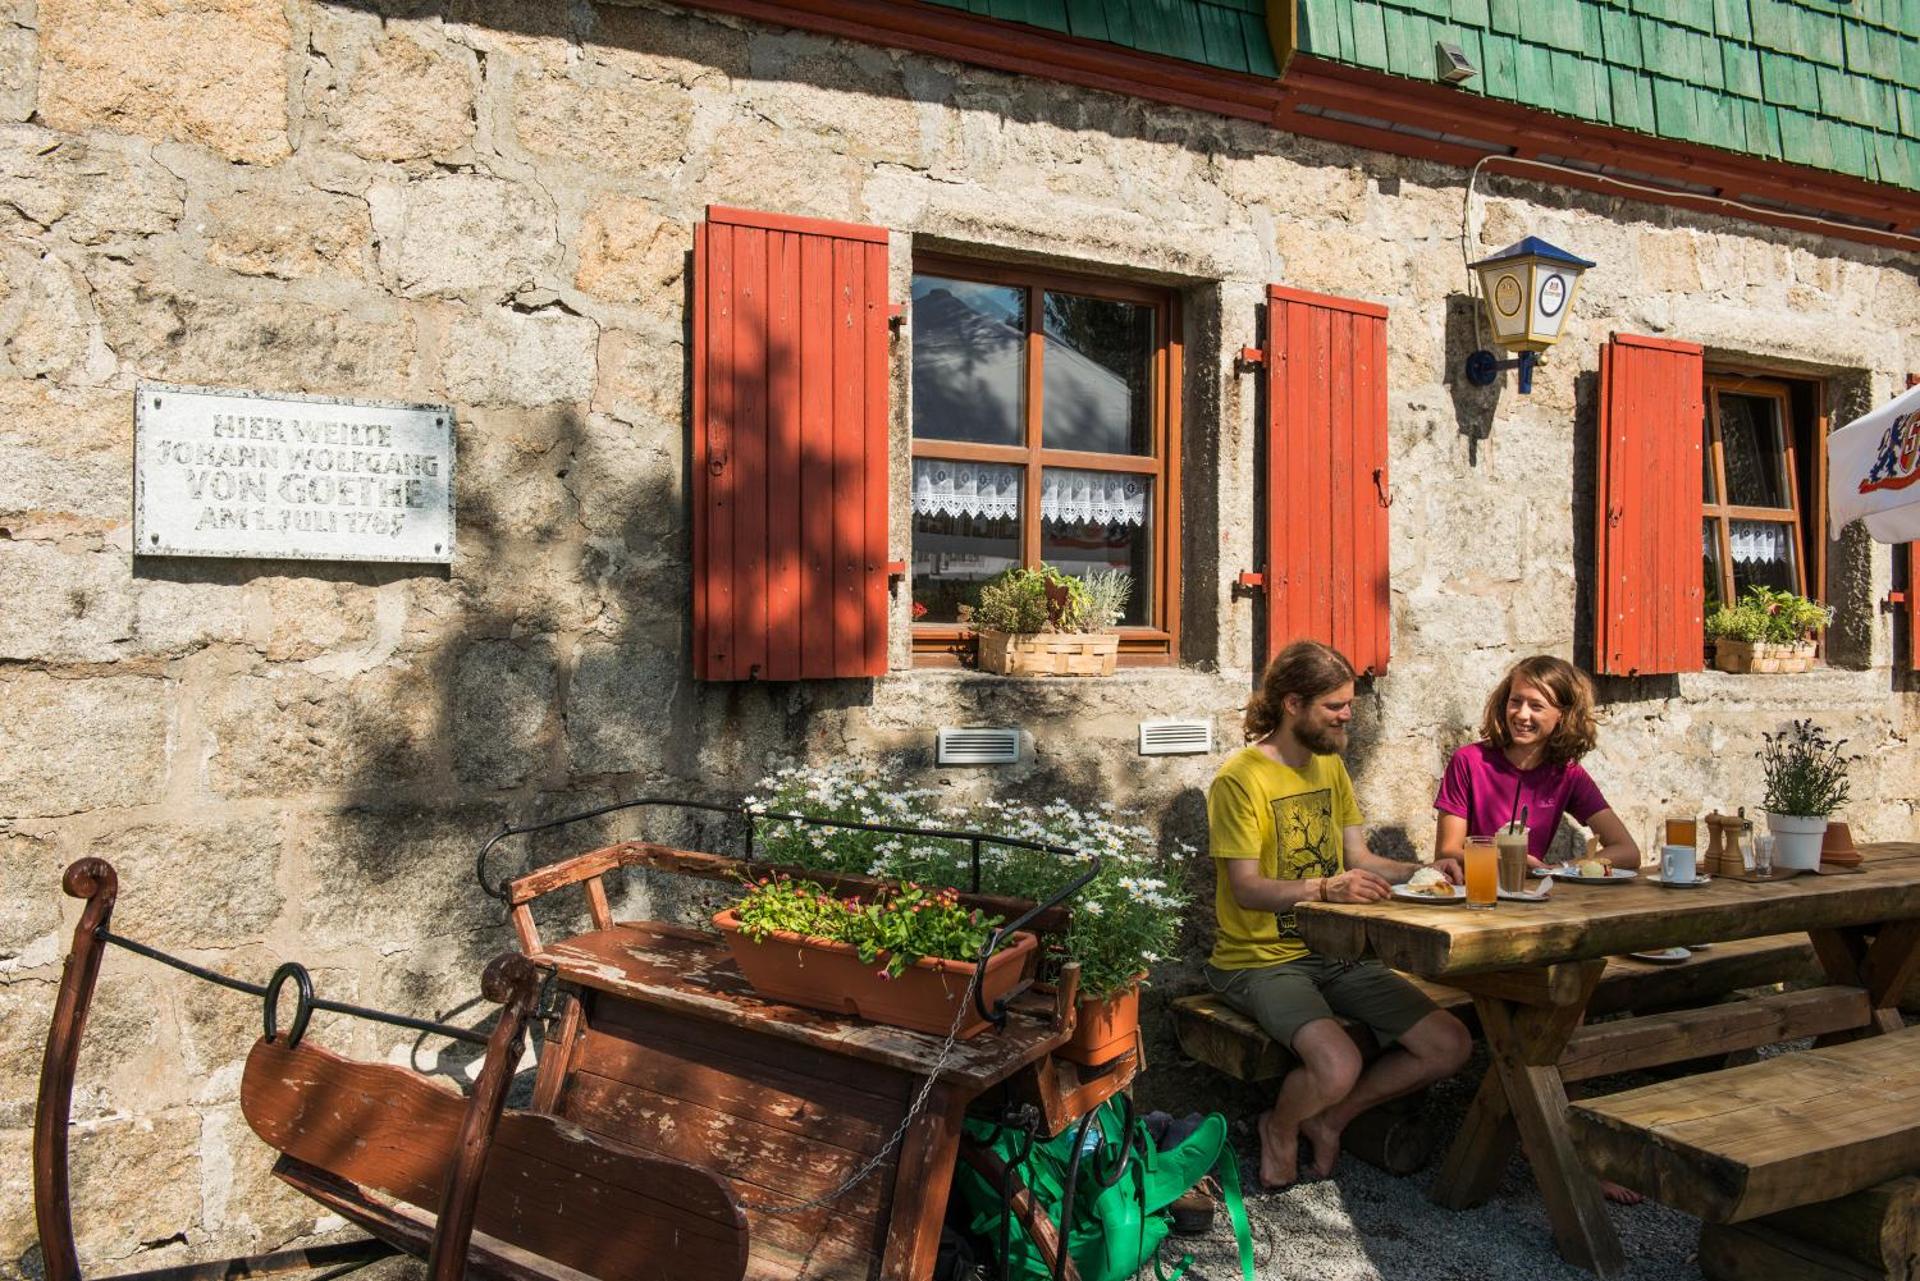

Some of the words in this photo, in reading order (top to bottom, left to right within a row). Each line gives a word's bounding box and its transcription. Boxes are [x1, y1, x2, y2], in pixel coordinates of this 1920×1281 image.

[213, 414, 286, 443] HIER
[293, 418, 393, 449] WEILTE
[155, 438, 280, 470] JOHANN
[287, 447, 439, 477] WOLFGANG
[184, 468, 268, 502] VON
[277, 472, 425, 509] GOETHE
[194, 506, 249, 532] AM
[278, 509, 337, 535] JULI
